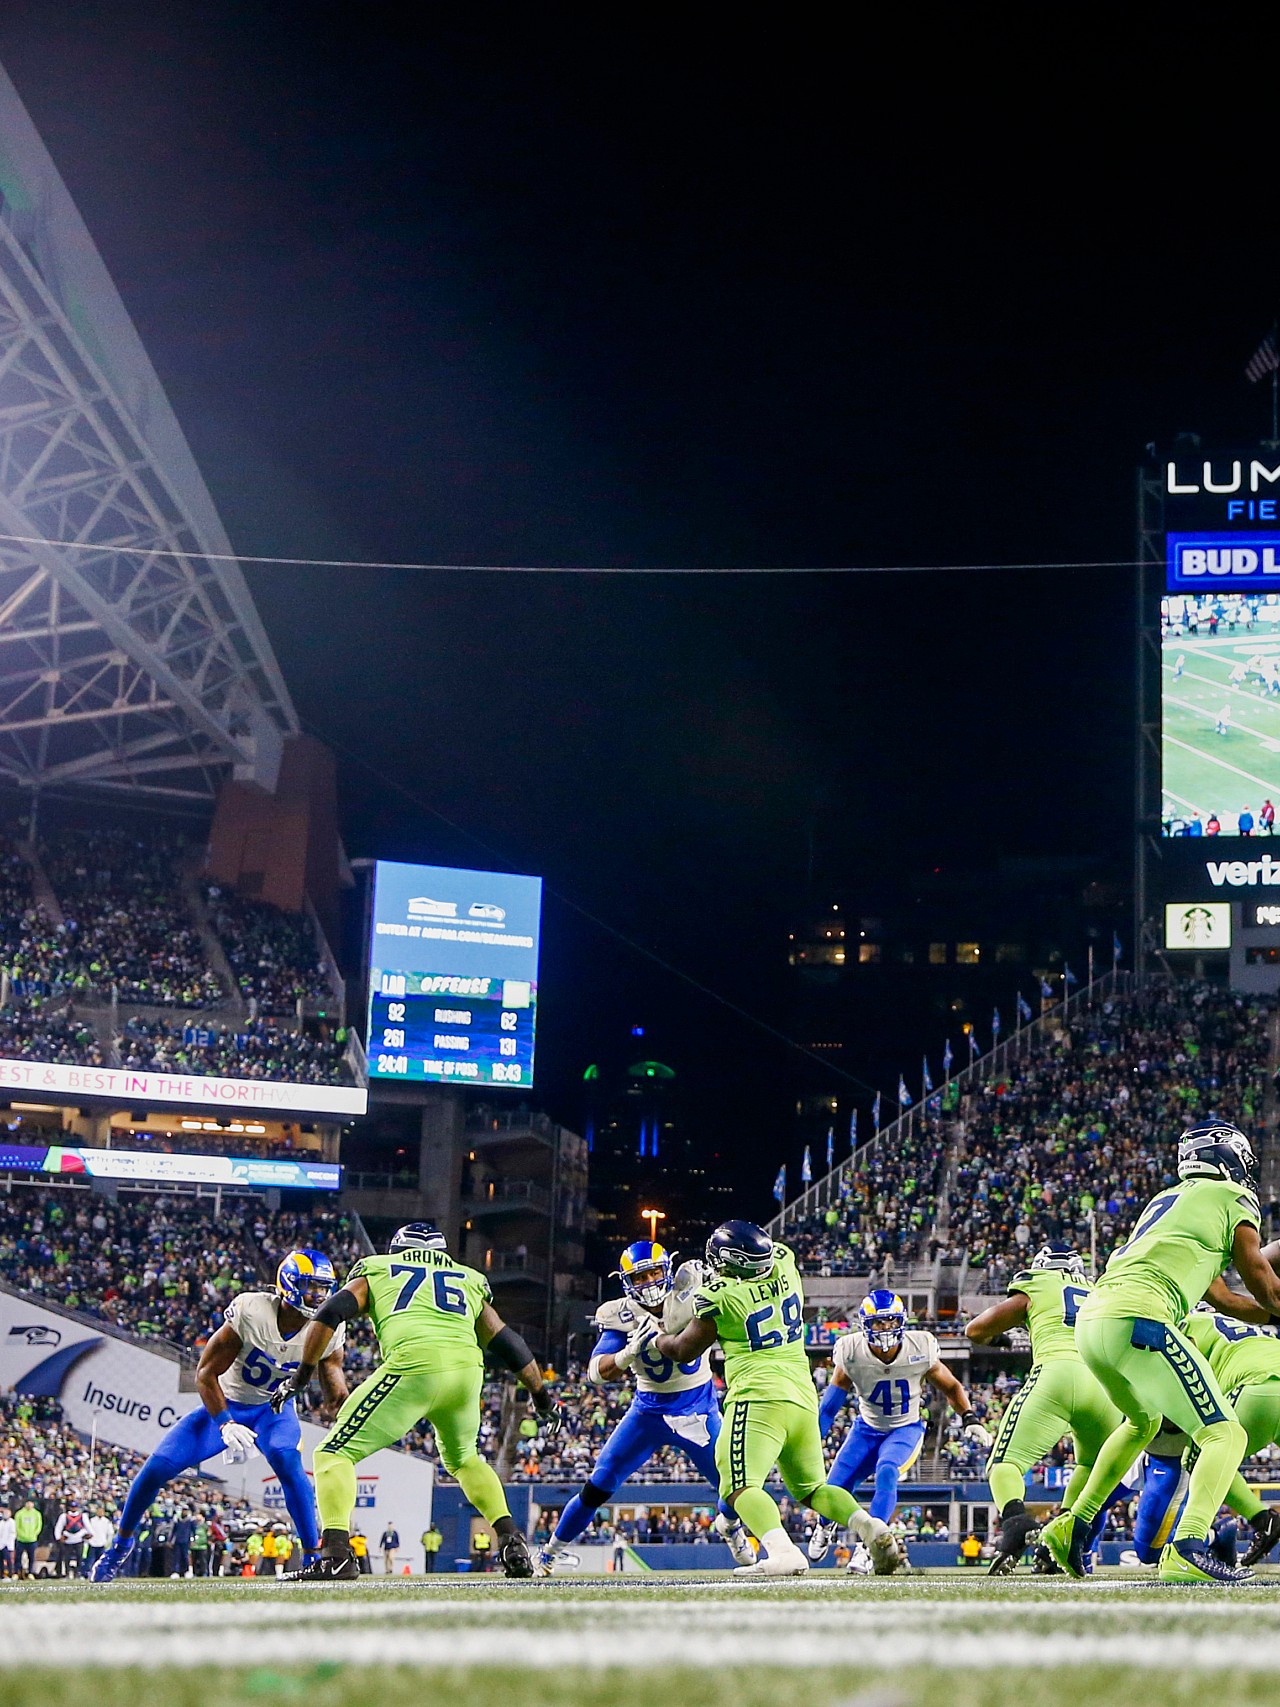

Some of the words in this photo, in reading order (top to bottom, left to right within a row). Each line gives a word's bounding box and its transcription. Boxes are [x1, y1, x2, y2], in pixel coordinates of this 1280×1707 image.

[1182, 548, 1258, 575] BUD
[420, 975, 492, 994] OFFENSE
[388, 1003, 406, 1022] 92
[500, 1012, 518, 1031] 62
[383, 1028, 405, 1048] 261
[433, 1034, 470, 1051] PASSING
[499, 1037, 517, 1056] 131
[43, 1069, 57, 1085] &
[68, 1071, 116, 1090] BEST
[125, 1077, 148, 1093] IN
[157, 1079, 193, 1096] THE
[423, 1060, 443, 1074] TIME
[455, 1062, 478, 1077] POSS
[491, 1062, 522, 1082] 16:43
[1115, 1192, 1183, 1258] 7
[402, 1250, 453, 1268] BROWN
[389, 1263, 468, 1317] 76
[748, 1274, 790, 1304] LEWIS
[745, 1292, 803, 1353] 68
[810, 1325, 831, 1345] 12
[241, 1346, 301, 1393] 52
[83, 1381, 151, 1421] Insure
[868, 1378, 911, 1416] 41
